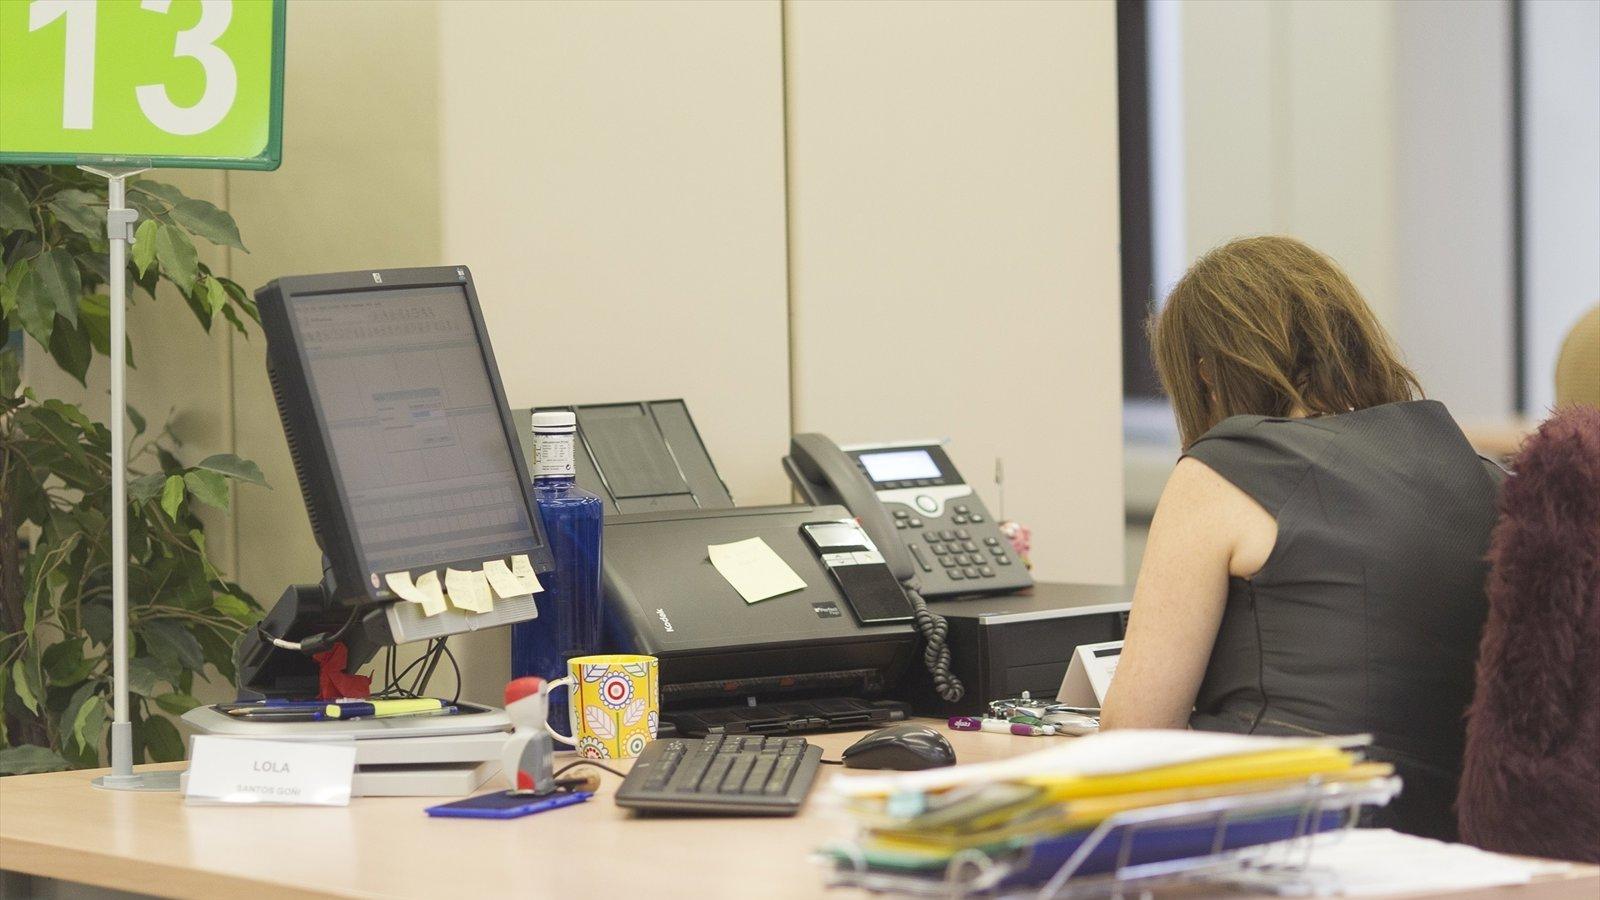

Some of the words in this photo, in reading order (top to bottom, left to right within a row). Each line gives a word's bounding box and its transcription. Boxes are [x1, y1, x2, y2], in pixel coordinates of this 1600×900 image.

[29, 0, 238, 136] 13
[656, 608, 674, 632] Kodak
[253, 761, 290, 773] LOLA
